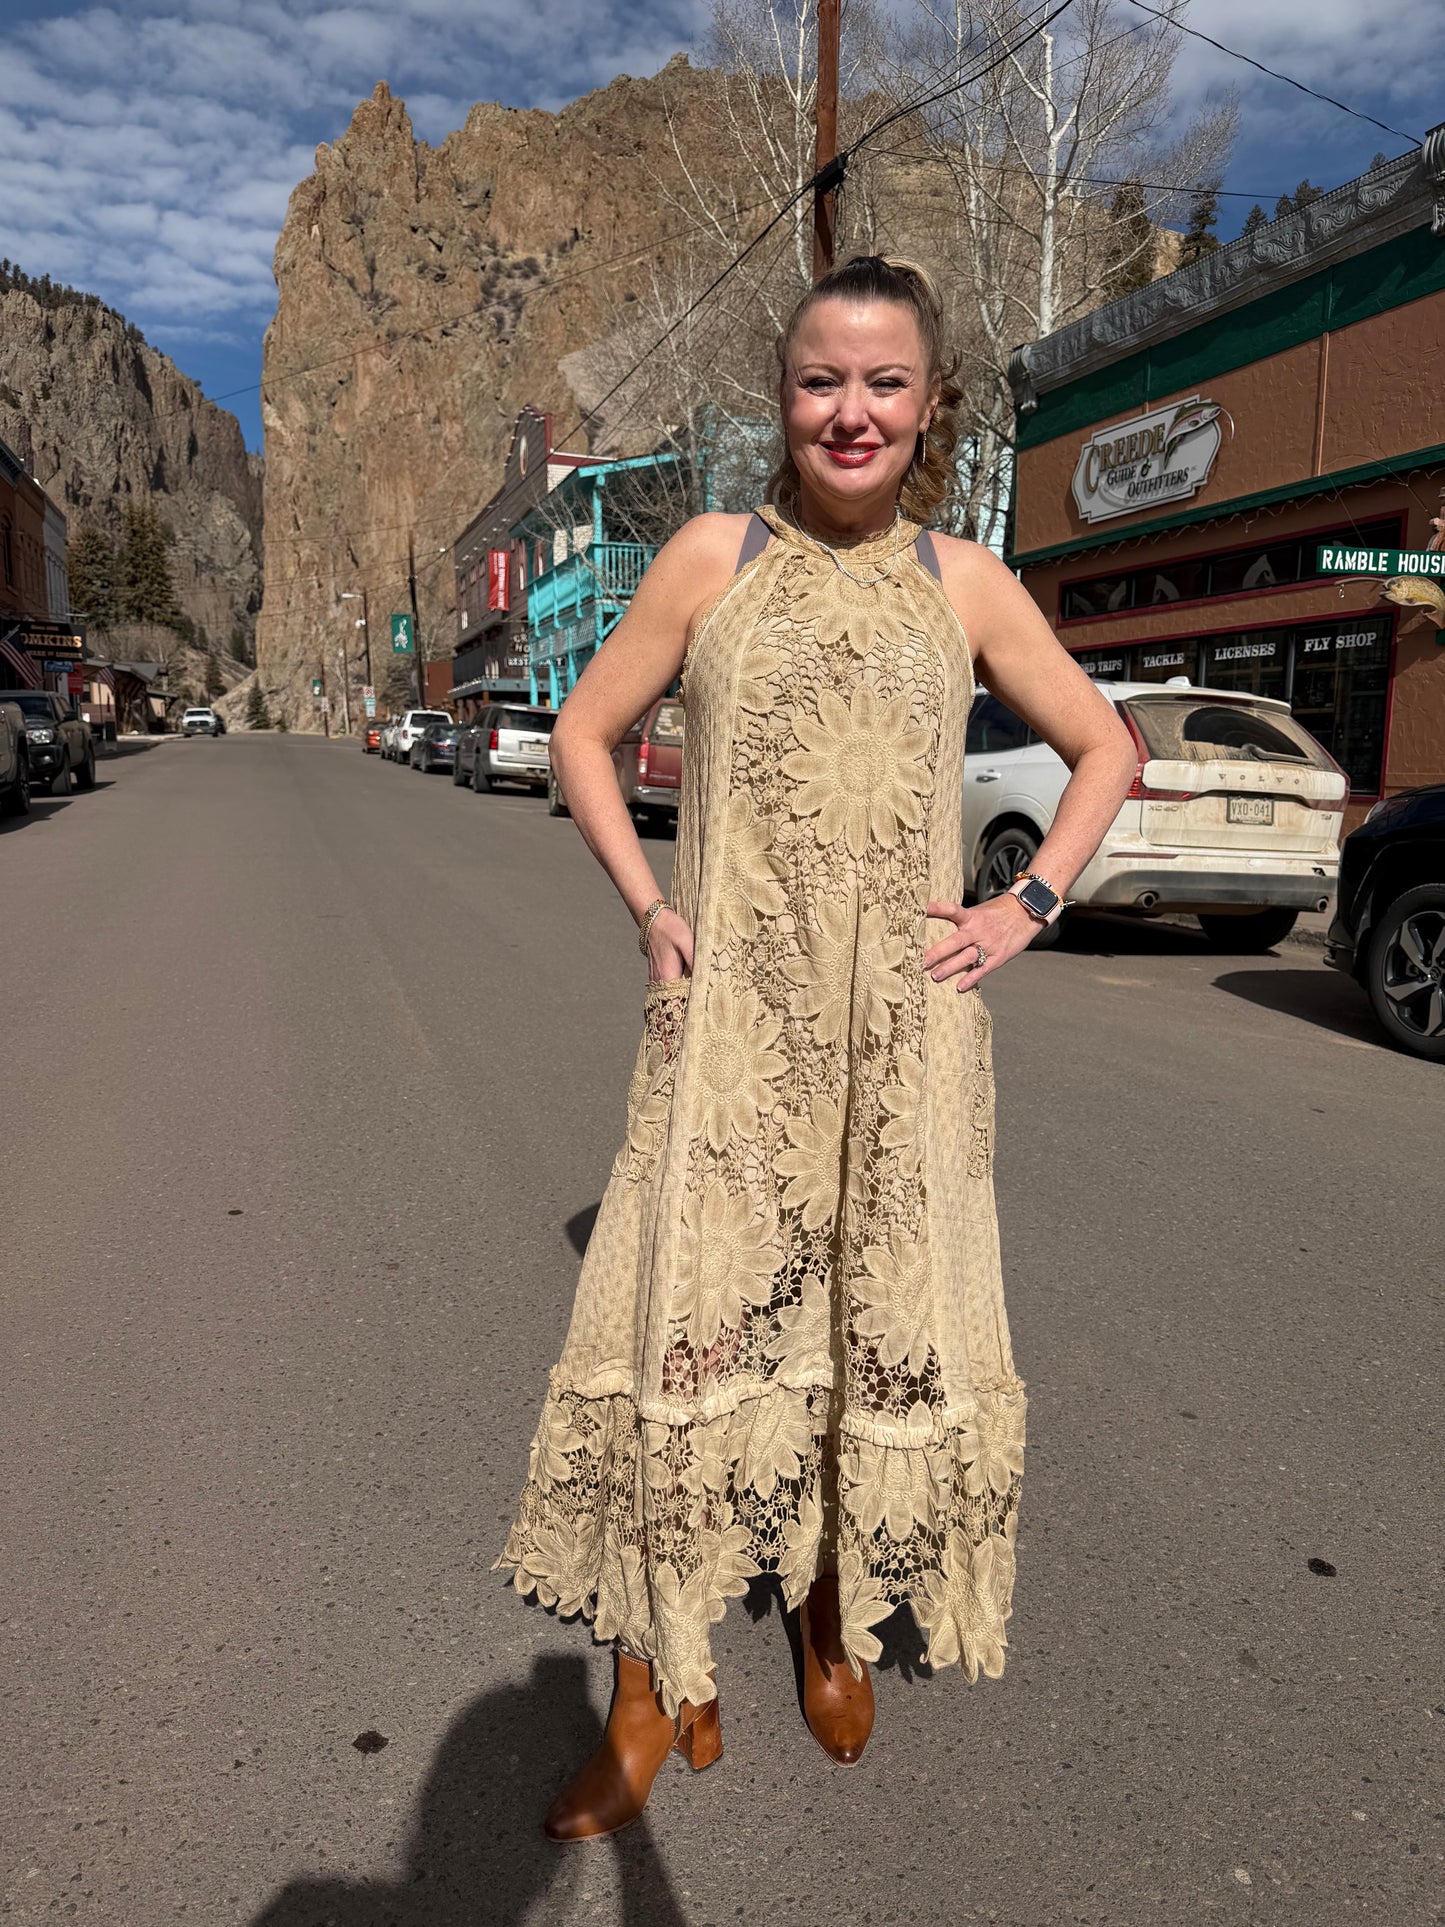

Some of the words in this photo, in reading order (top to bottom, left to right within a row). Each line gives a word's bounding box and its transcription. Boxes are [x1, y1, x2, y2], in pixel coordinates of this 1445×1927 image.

[1085, 422, 1166, 493] CREEDE
[1106, 464, 1137, 487] GUIDE
[1140, 458, 1152, 477] &
[1127, 467, 1190, 498] OUTFITTERS
[1322, 549, 1389, 572] RAMBLE
[1214, 643, 1276, 661] LICENSES
[1303, 636, 1332, 652] FLY
[1335, 632, 1377, 649] SHOP
[1097, 659, 1123, 673] TRIPS
[1143, 653, 1185, 668] TACKLE
[1218, 773, 1300, 785] VOLVO
